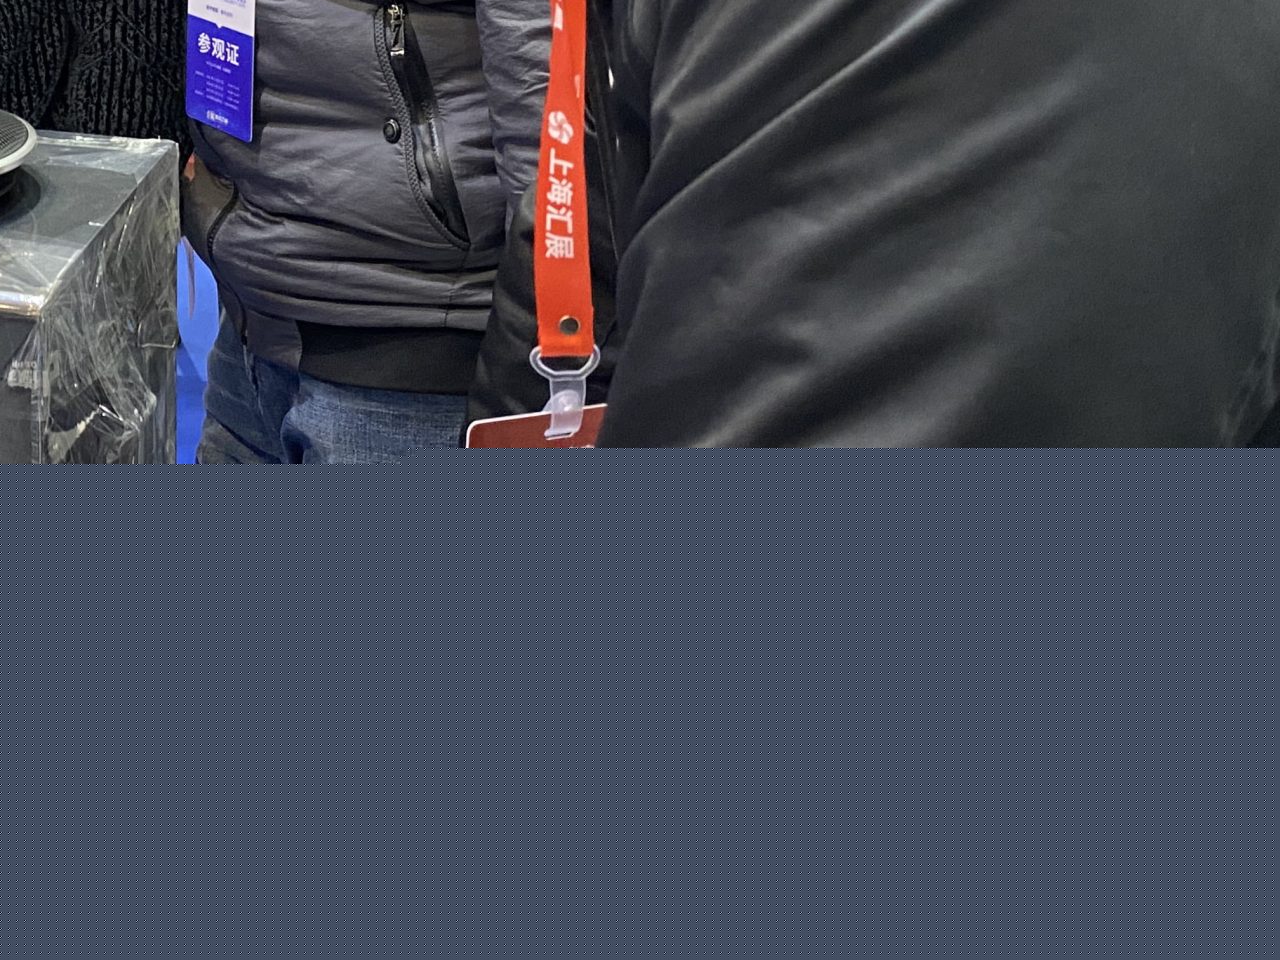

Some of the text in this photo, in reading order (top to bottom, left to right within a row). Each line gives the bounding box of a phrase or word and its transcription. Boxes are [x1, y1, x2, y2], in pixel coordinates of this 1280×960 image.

[197, 32, 241, 66] 参观证
[544, 148, 575, 260] 上海汇展
